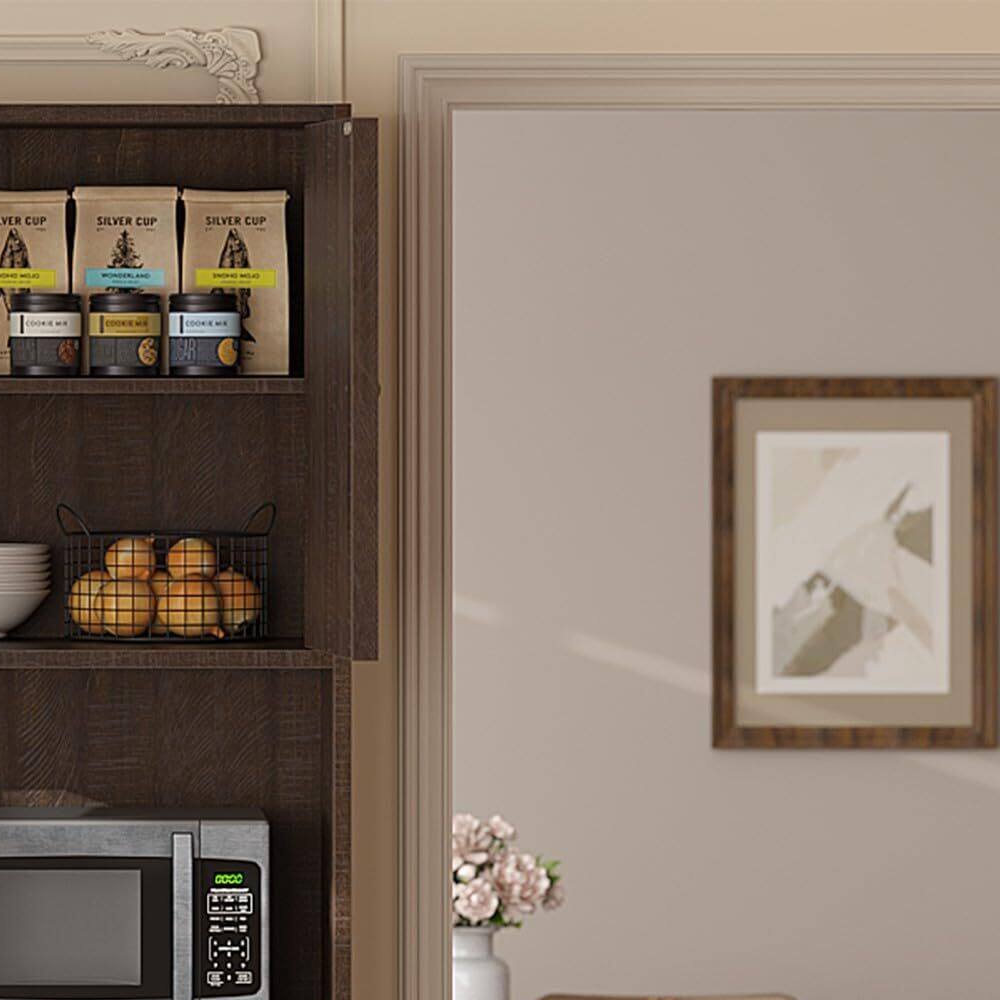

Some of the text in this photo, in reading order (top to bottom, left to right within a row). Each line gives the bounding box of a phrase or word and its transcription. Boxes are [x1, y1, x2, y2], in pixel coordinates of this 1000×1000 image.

[25, 216, 47, 226] CUP
[96, 216, 158, 226] SILVER CUP
[205, 216, 267, 226] SILVER CUP
